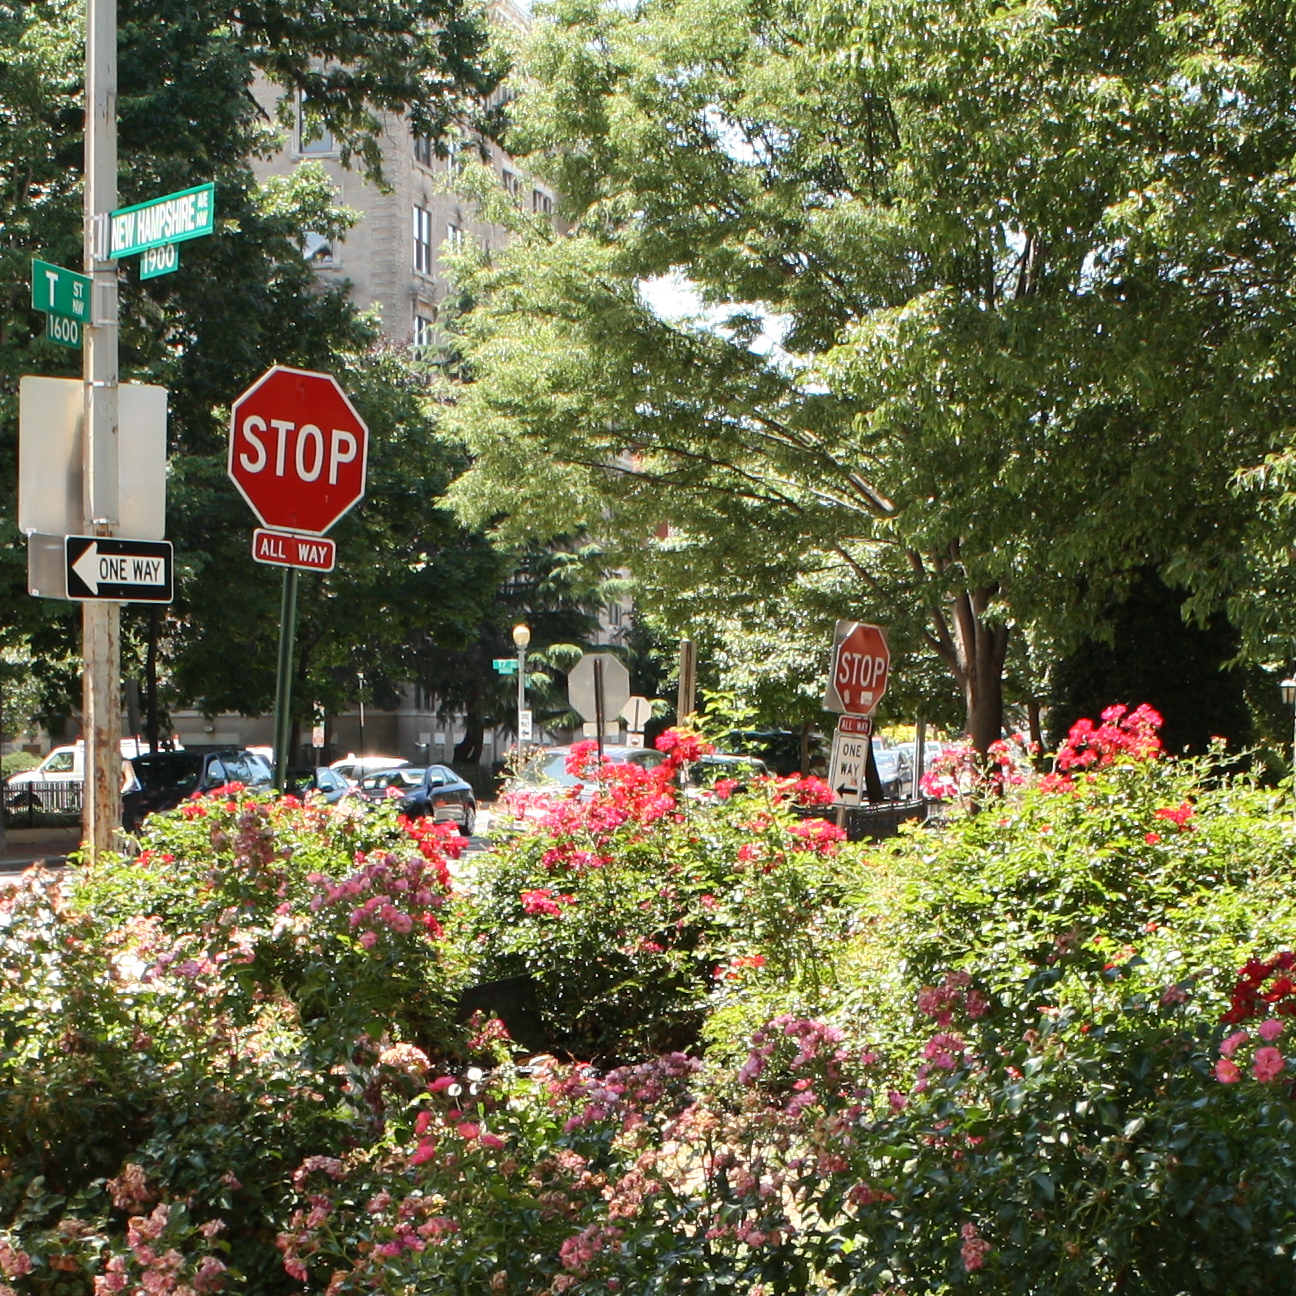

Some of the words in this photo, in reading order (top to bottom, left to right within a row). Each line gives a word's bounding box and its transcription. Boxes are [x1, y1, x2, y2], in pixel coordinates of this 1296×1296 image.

[111, 212, 136, 252] NEW
[137, 193, 196, 246] HAMPSHIRE
[196, 210, 208, 228] NW
[144, 244, 175, 274] 1900
[45, 270, 59, 307] T
[73, 281, 84, 298] ST
[72, 299, 85, 315] NW
[50, 314, 78, 344] 1600
[239, 414, 358, 485] STOP
[260, 538, 286, 559] ALL
[298, 542, 328, 564] WAY
[99, 557, 128, 581] ONE
[132, 558, 161, 582] WAY
[839, 651, 885, 688] STOP
[841, 719, 853, 731] ALL
[856, 721, 869, 733] WAY
[843, 743, 862, 758] ONE
[840, 763, 860, 777] WAY
